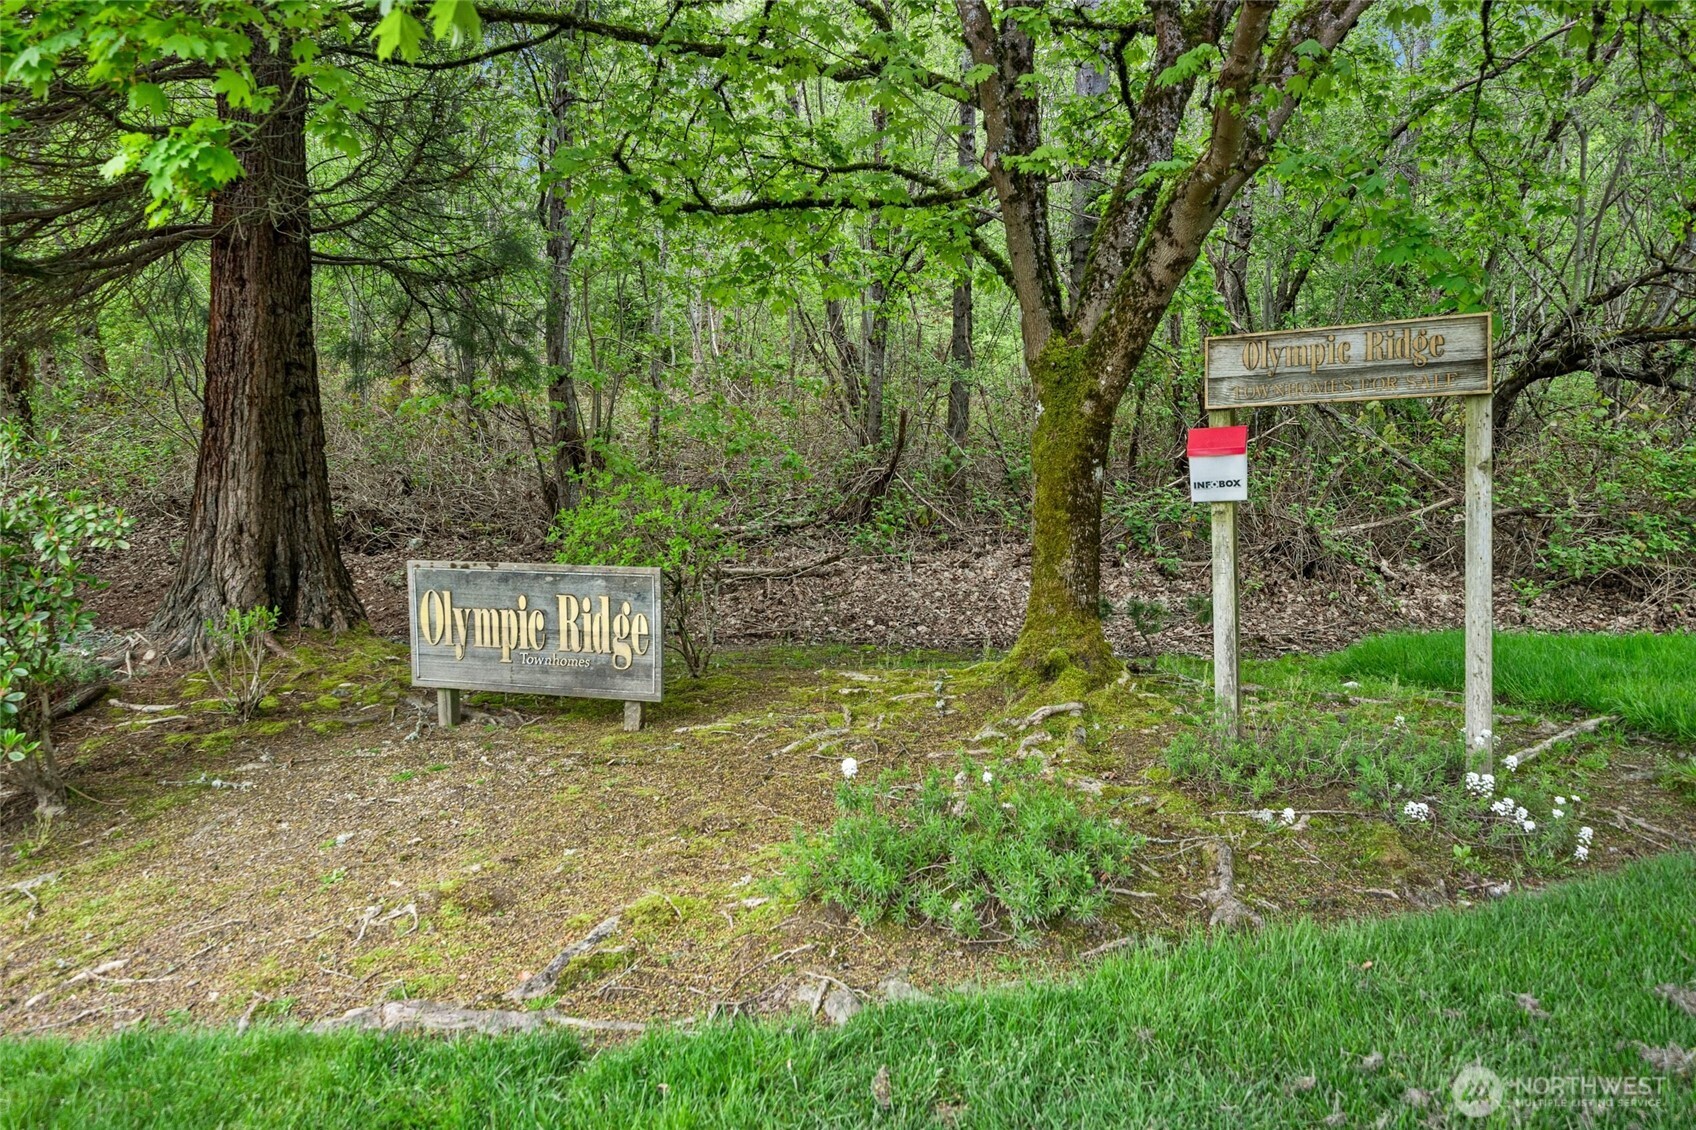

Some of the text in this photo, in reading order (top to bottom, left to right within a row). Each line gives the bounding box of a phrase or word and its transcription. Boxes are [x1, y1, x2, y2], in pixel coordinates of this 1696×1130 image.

[1242, 328, 1445, 377] Olympic Ridge
[1232, 372, 1459, 400] TOWNHOMES FOR SALE
[420, 589, 650, 670] Olympic Ridge
[520, 652, 591, 667] Townhomes
